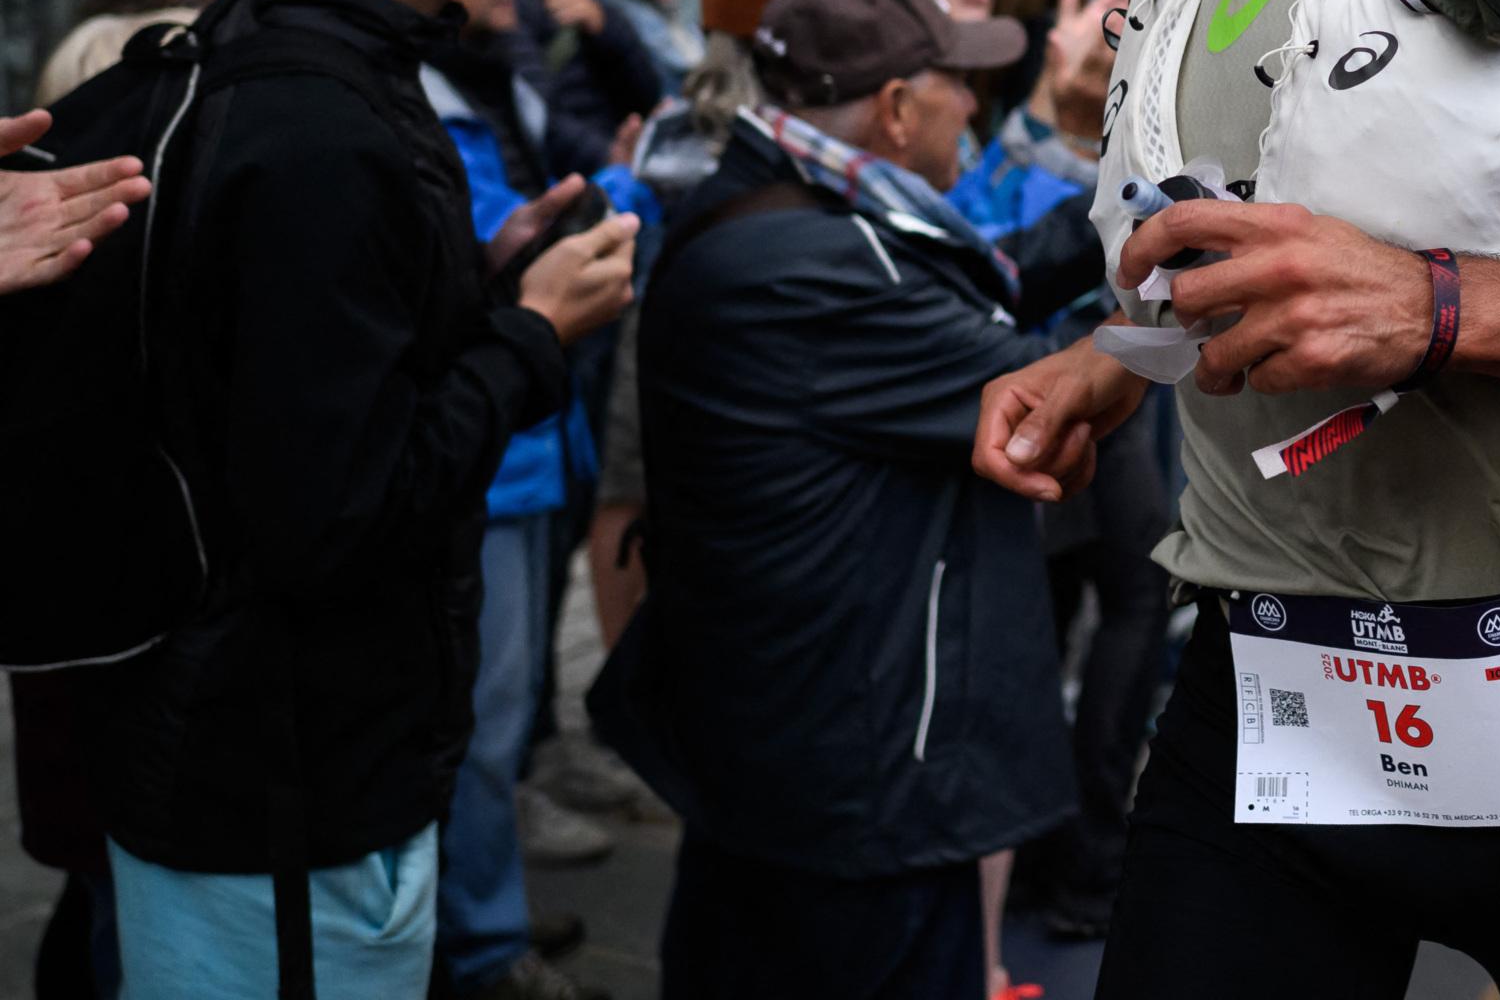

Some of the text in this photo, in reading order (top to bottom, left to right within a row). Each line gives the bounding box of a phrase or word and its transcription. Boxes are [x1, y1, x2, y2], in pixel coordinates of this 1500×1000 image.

[1351, 610, 1377, 622] HOKA
[1351, 619, 1406, 642] UTMB
[1321, 653, 1335, 681] 2025
[1366, 699, 1434, 748] 16
[1380, 753, 1428, 777] Ben
[1386, 779, 1429, 792] DHIMAN
